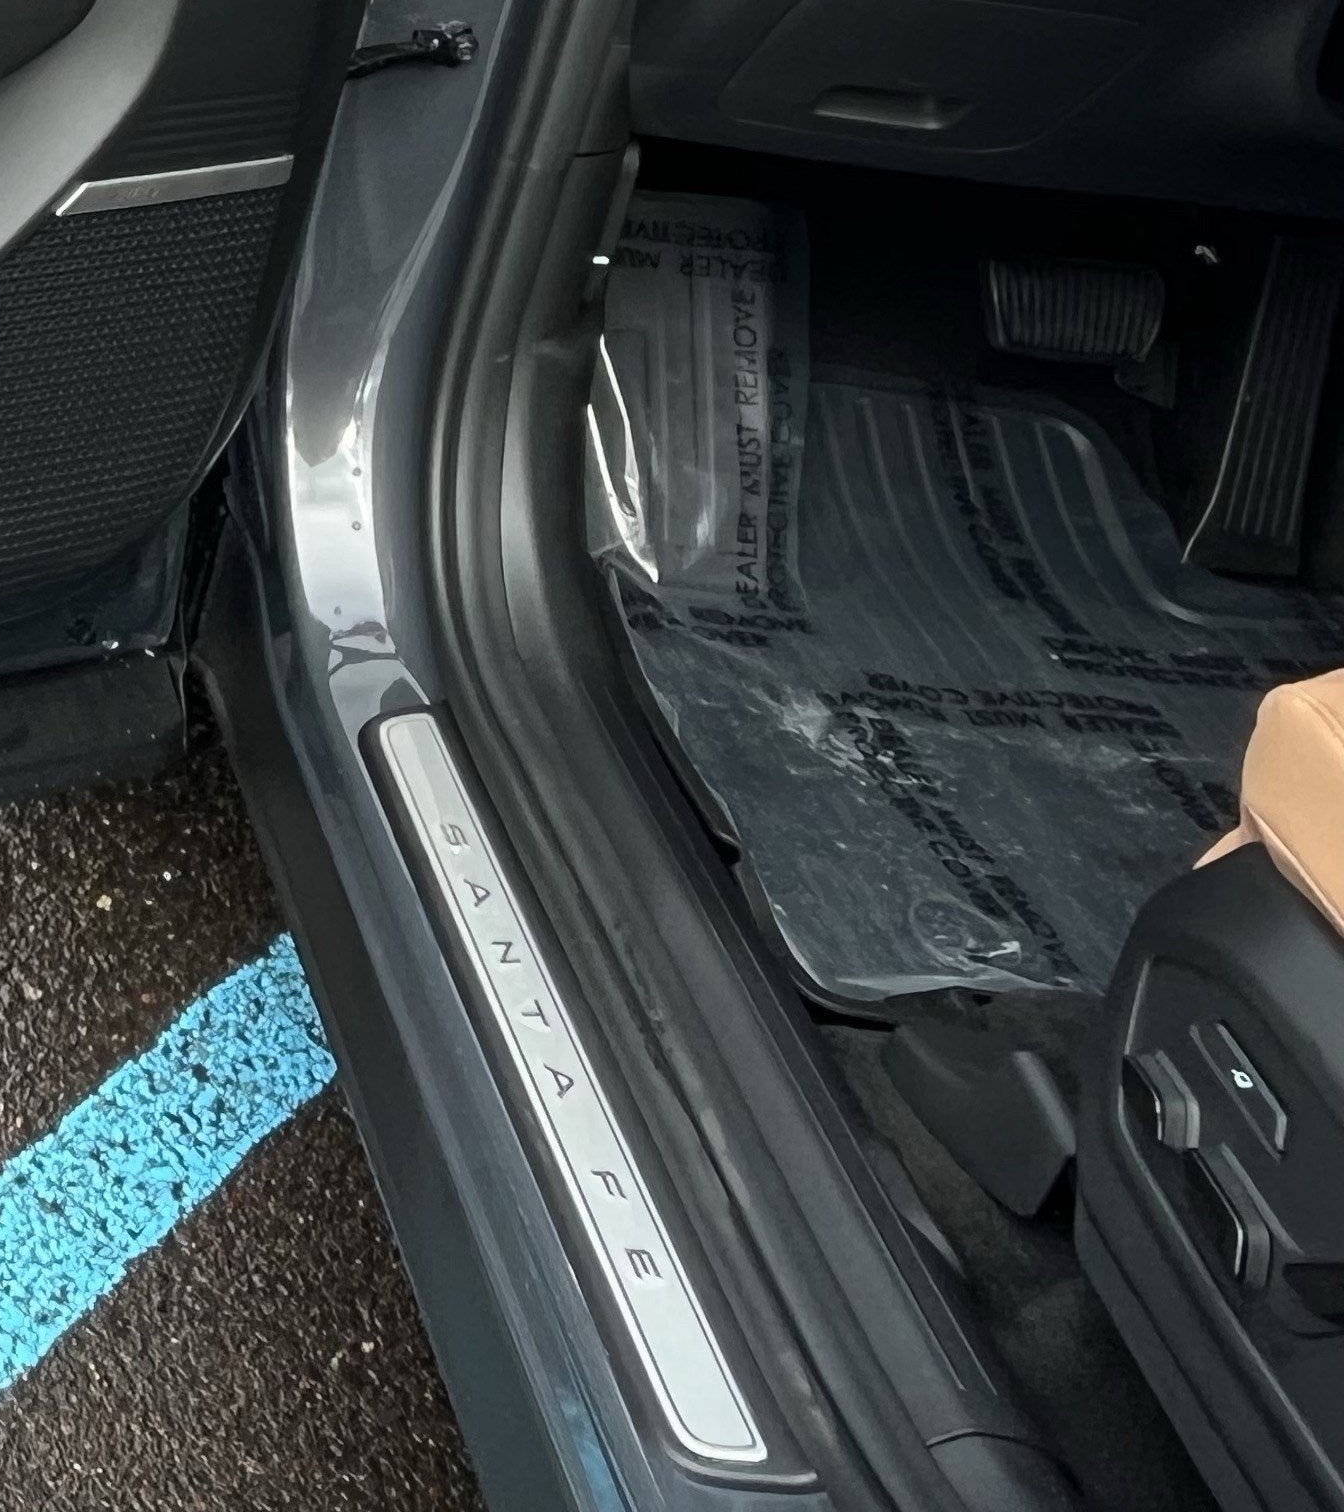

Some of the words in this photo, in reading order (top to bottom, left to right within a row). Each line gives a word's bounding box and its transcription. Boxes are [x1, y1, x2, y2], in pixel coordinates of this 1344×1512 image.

[730, 289, 759, 406] REMOVE
[439, 822, 575, 1099] SANTA
[590, 1168, 666, 1281] FE
